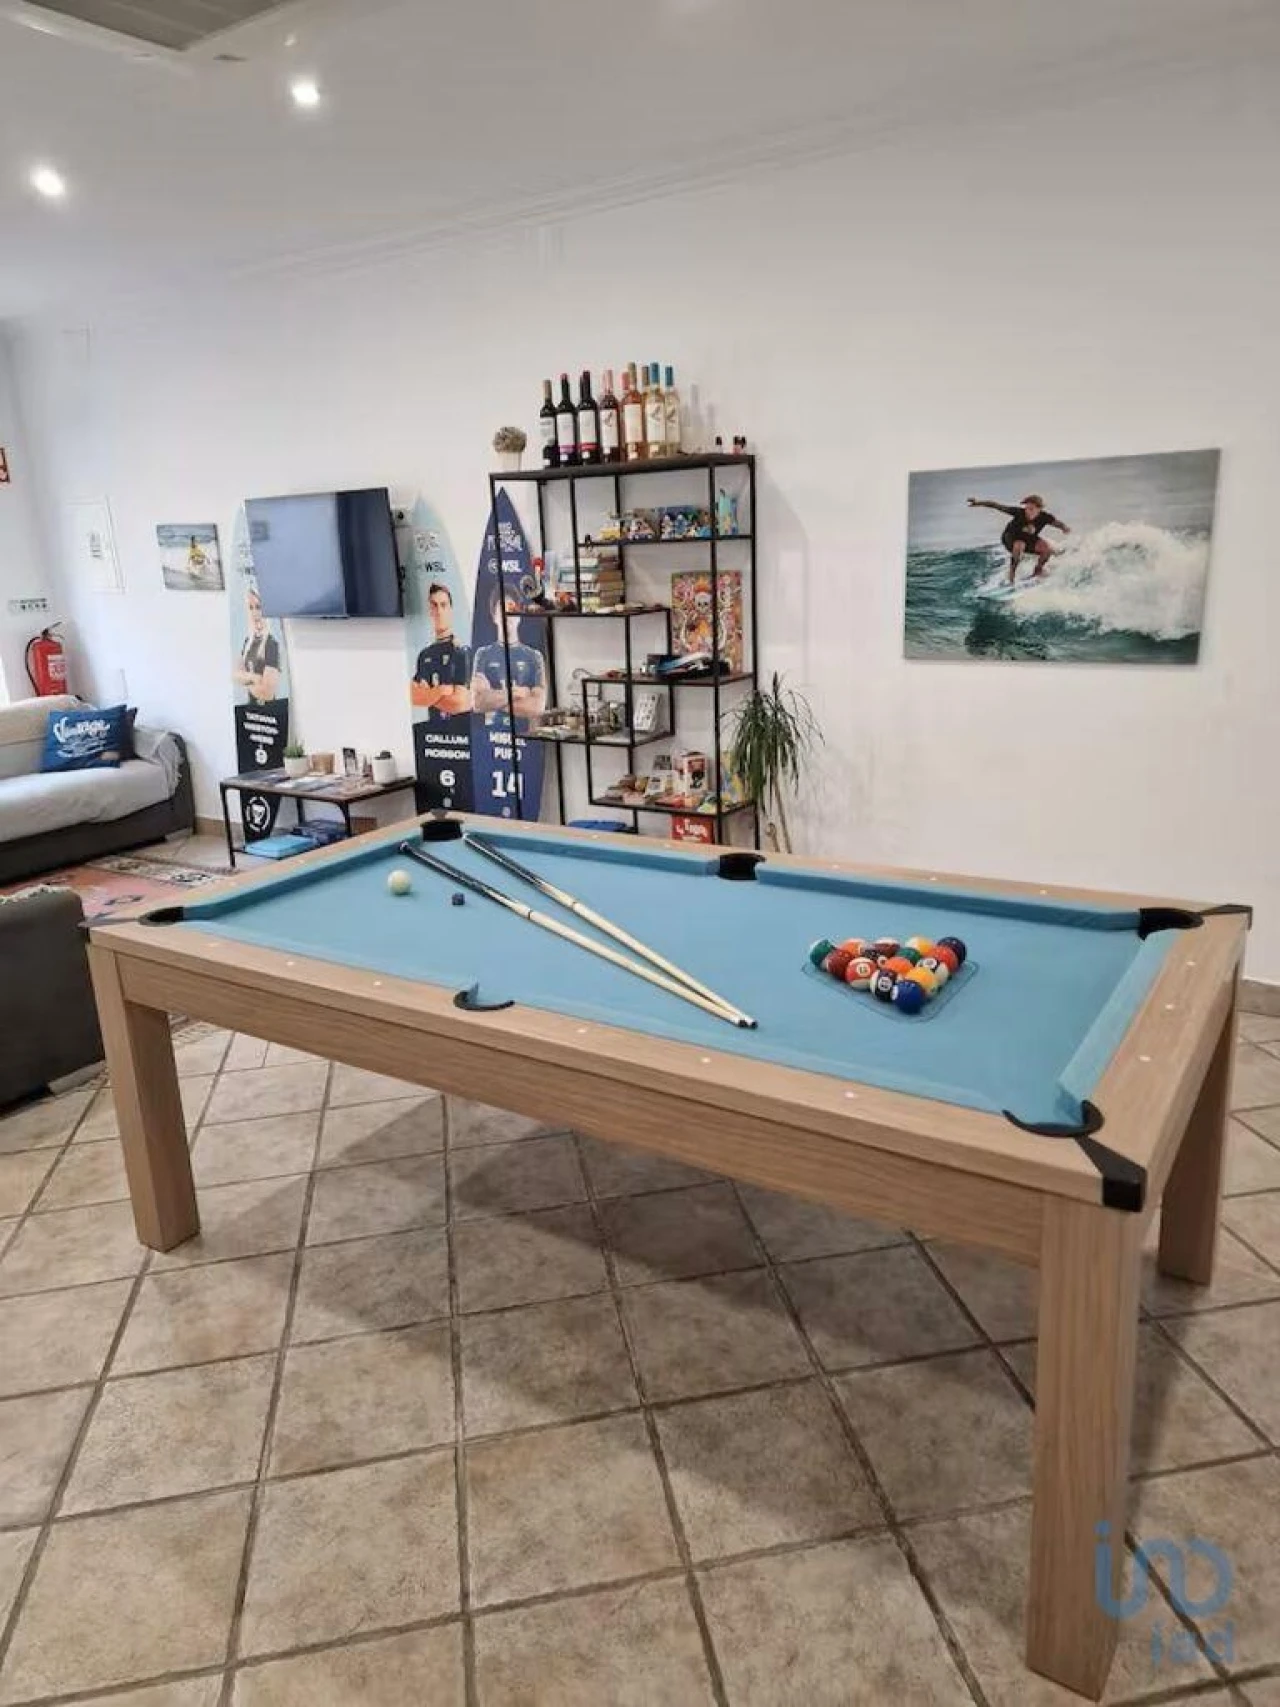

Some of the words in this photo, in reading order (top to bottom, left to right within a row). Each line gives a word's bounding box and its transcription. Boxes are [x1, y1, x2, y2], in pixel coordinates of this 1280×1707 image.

[425, 734, 469, 745] CALLUM
[424, 748, 471, 760] ROBSON
[440, 769, 455, 786] 6
[491, 771, 524, 800] 14
